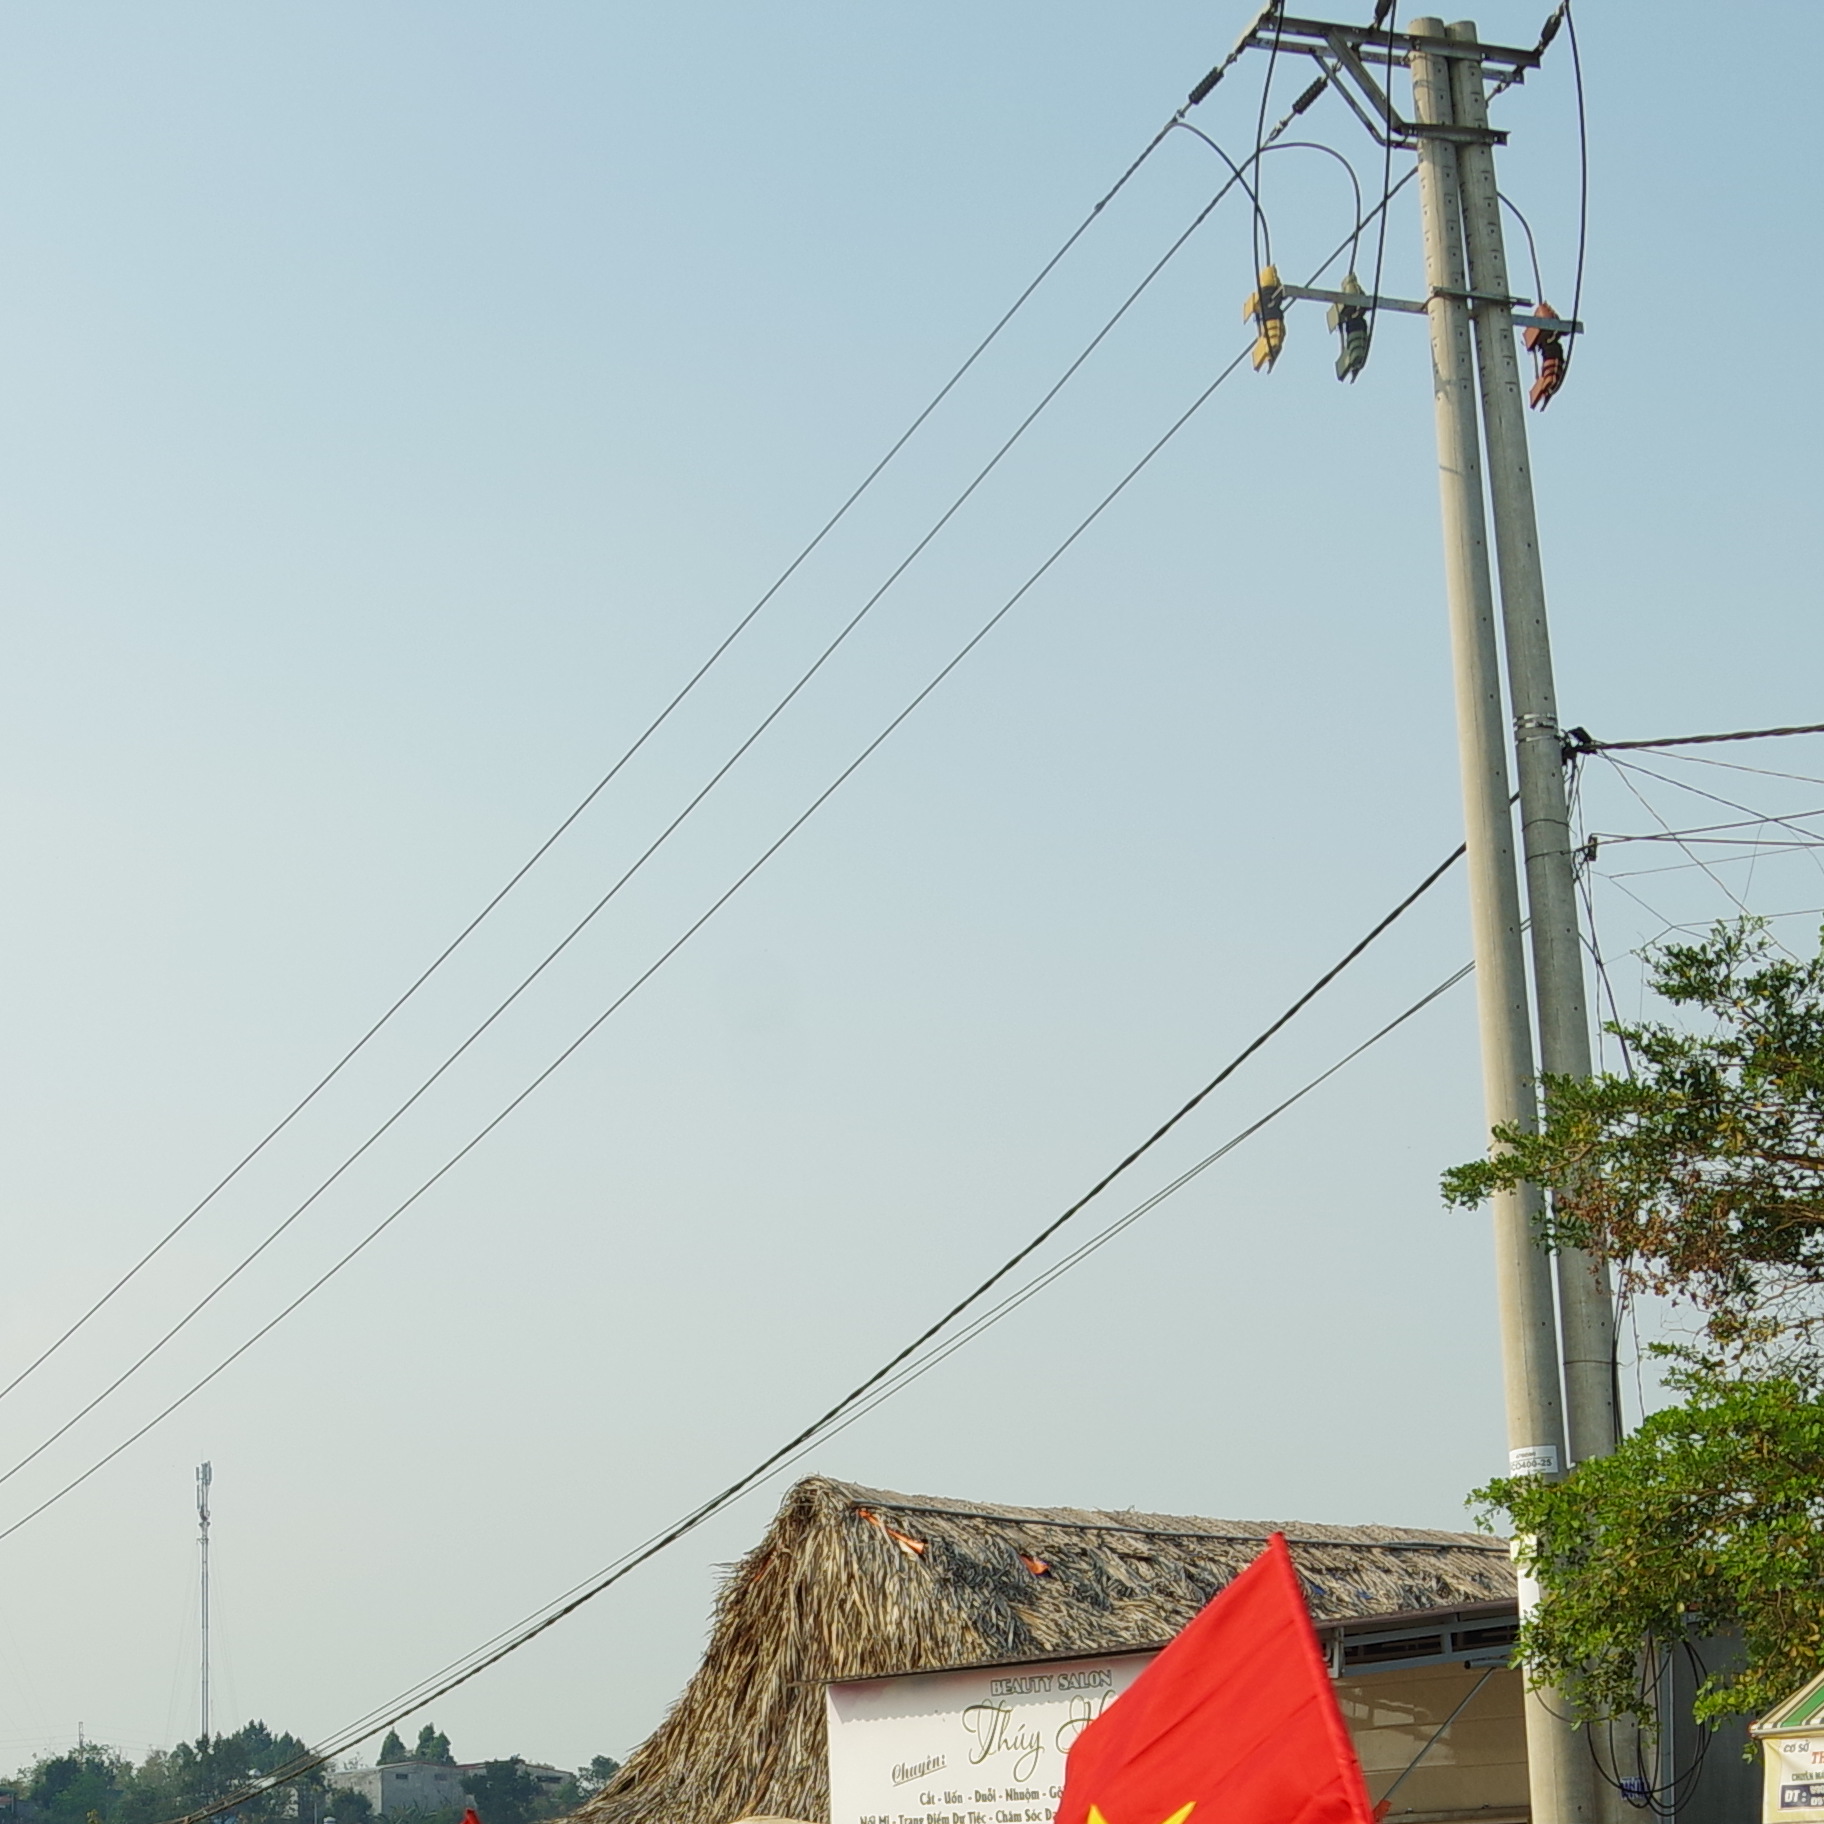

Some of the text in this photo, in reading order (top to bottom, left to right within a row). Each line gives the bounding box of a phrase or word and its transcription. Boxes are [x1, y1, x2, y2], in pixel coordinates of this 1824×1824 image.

[991, 1669, 1113, 1697] BEAUTY SALON
[961, 1698, 1045, 1783] Thúy
[1024, 1808, 1042, 1822] Sóc
